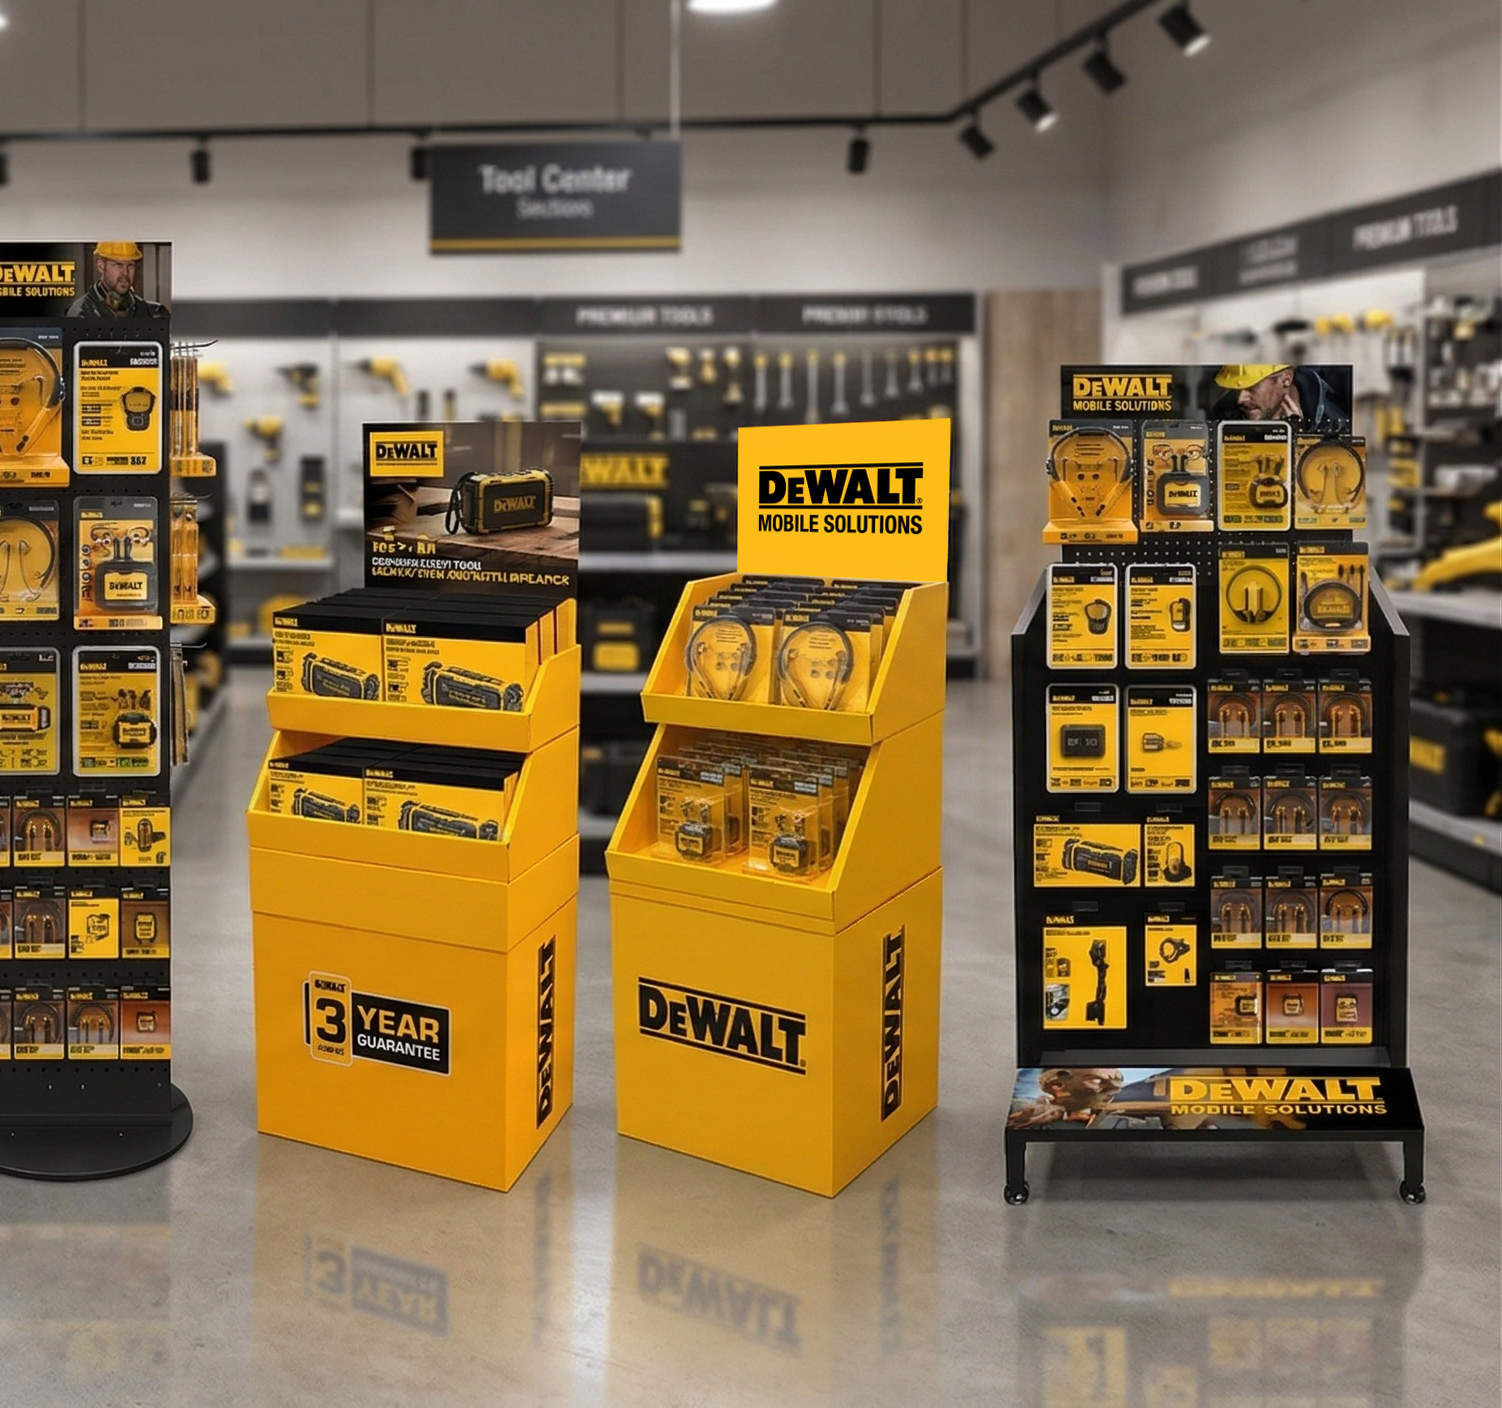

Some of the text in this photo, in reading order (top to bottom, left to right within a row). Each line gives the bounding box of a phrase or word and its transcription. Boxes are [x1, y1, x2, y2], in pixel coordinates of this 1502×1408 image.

[478, 164, 632, 194] Tool Center
[1073, 378, 1172, 398] DEWALT
[1073, 400, 1112, 412] MOBILE
[375, 443, 438, 460] DEWALT
[759, 467, 924, 504] DEWALT
[758, 514, 923, 535] MOBILE SOLUTIONS
[315, 997, 440, 1044] 3 YEAR
[639, 984, 806, 1067] DEWALT
[884, 930, 903, 1120] DEWALT
[357, 1033, 441, 1061] GUARANTEE
[1170, 1078, 1381, 1101] DEWALT
[1171, 1104, 1387, 1115] MOBILE SOLUTIONS
